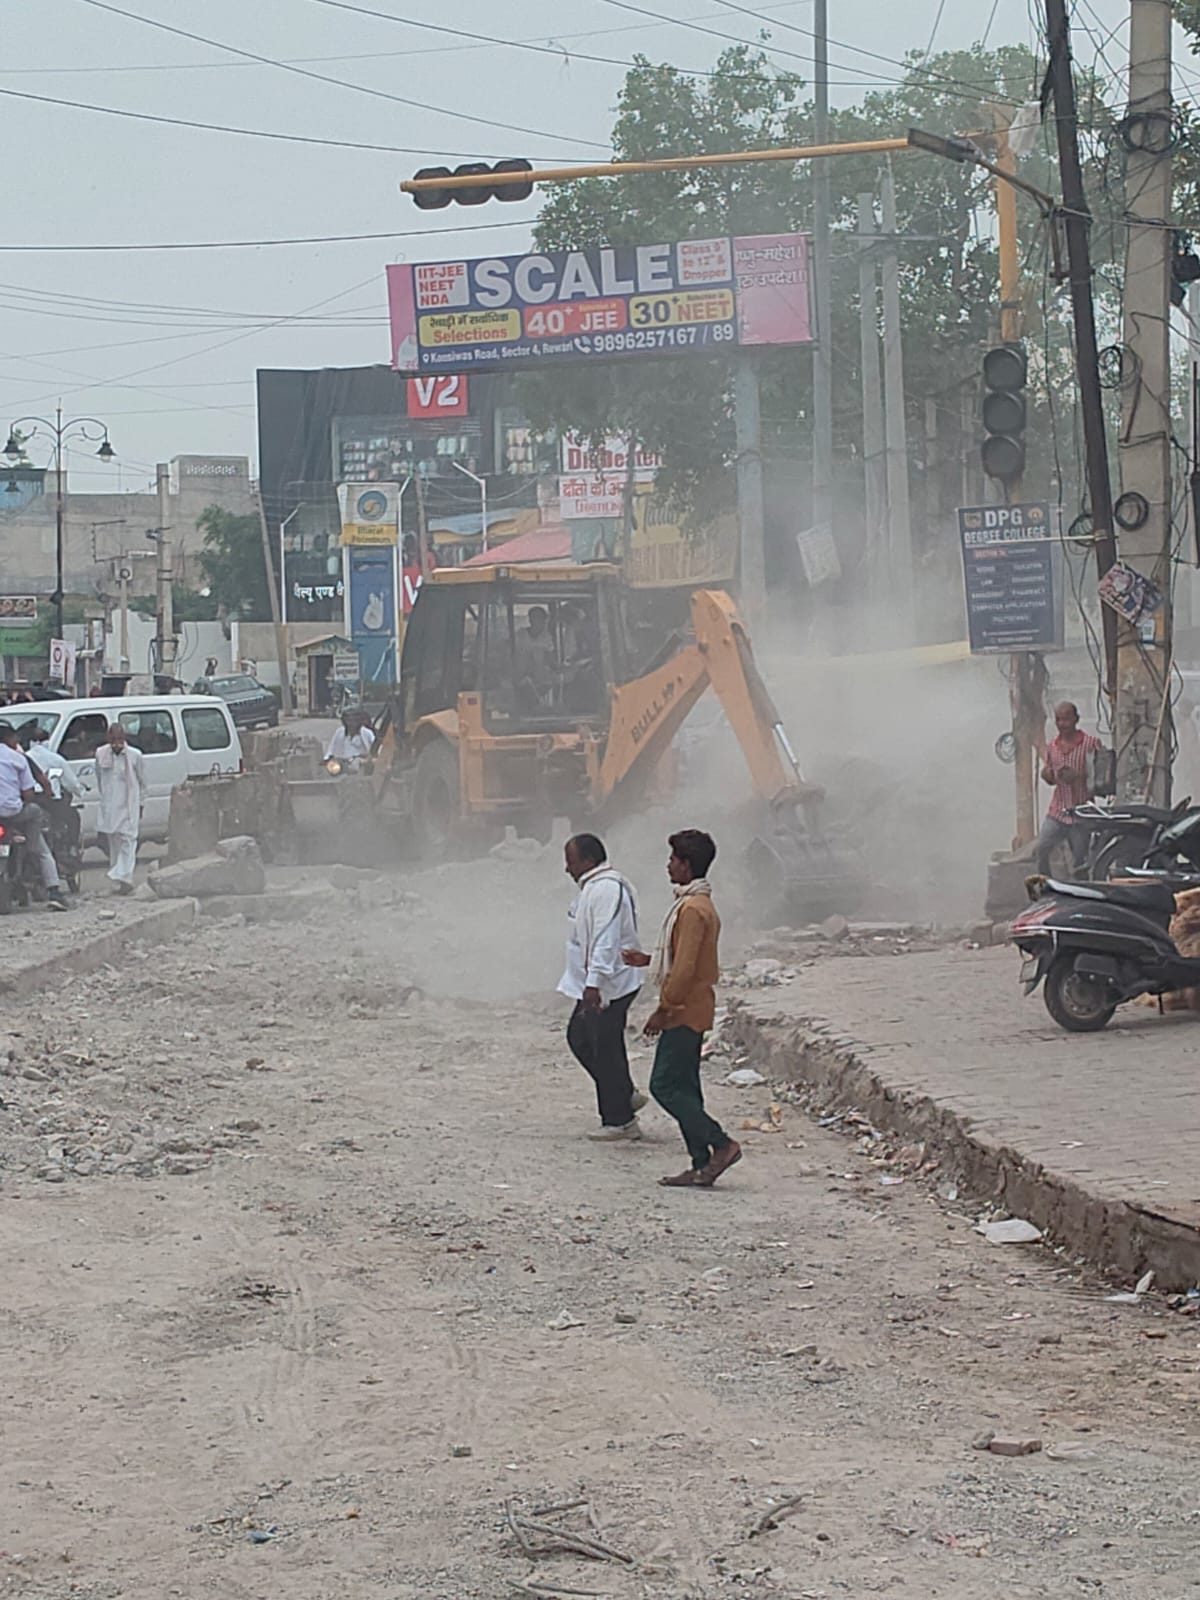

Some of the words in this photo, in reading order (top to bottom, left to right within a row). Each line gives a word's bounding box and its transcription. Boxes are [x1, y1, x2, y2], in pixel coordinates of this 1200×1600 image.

[418, 264, 464, 279] IIT-JEE
[475, 244, 673, 307] SCALE
[420, 279, 455, 292] NEET
[421, 294, 449, 306] NDA
[580, 311, 618, 331] JEE
[678, 301, 730, 322] NEET
[434, 327, 508, 343] Selections
[502, 345, 530, 358] Sector
[594, 327, 697, 353] 9896257167
[712, 324, 733, 342] 89
[414, 376, 459, 407] V2
[984, 507, 1022, 527] DPG
[964, 529, 1000, 544] DEGREE
[1003, 526, 1046, 540] COLLEGE
[631, 699, 664, 745] BULL
